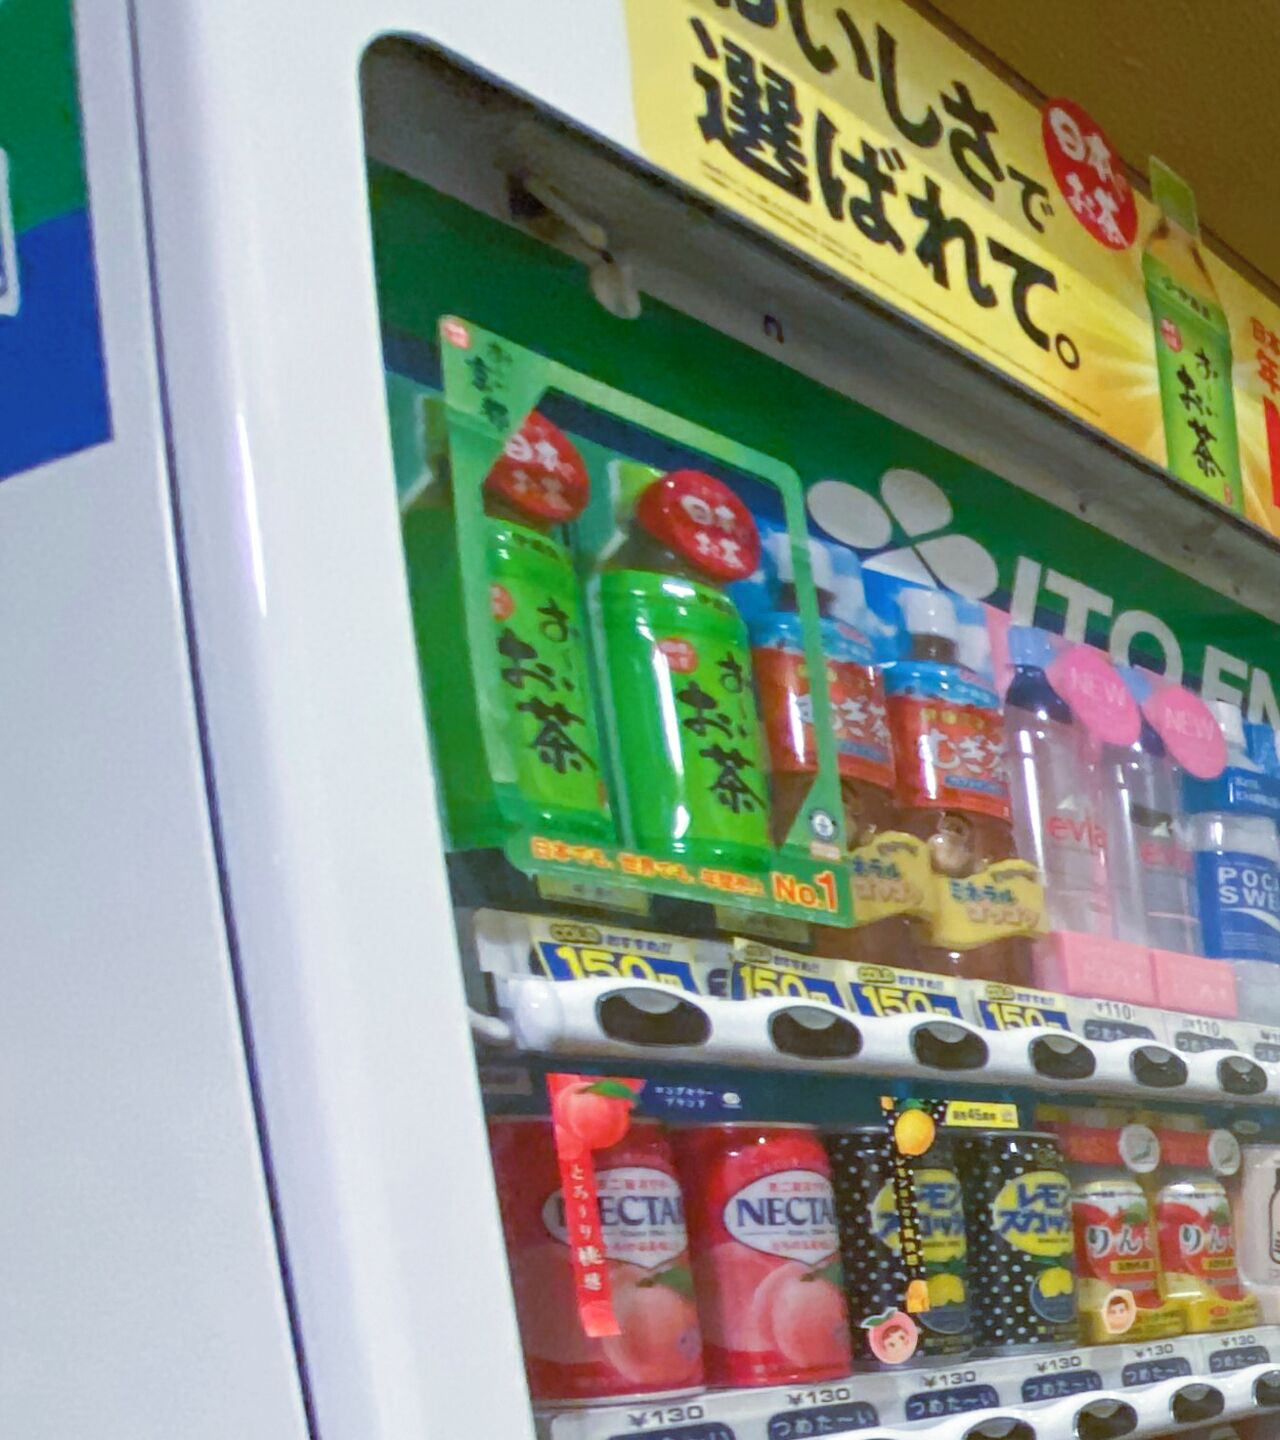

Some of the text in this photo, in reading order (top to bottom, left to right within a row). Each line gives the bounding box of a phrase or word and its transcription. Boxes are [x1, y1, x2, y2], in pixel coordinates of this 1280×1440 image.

[690, 16, 1081, 371] 選ばれて。
[769, 870, 839, 913] No.1
[921, 1370, 977, 1388] ¥130
[787, 1388, 851, 1405] ¥130
[908, 1391, 995, 1415] つめた〜い
[627, 1404, 704, 1427] ¥130
[771, 1410, 875, 1437] つめた〜い
